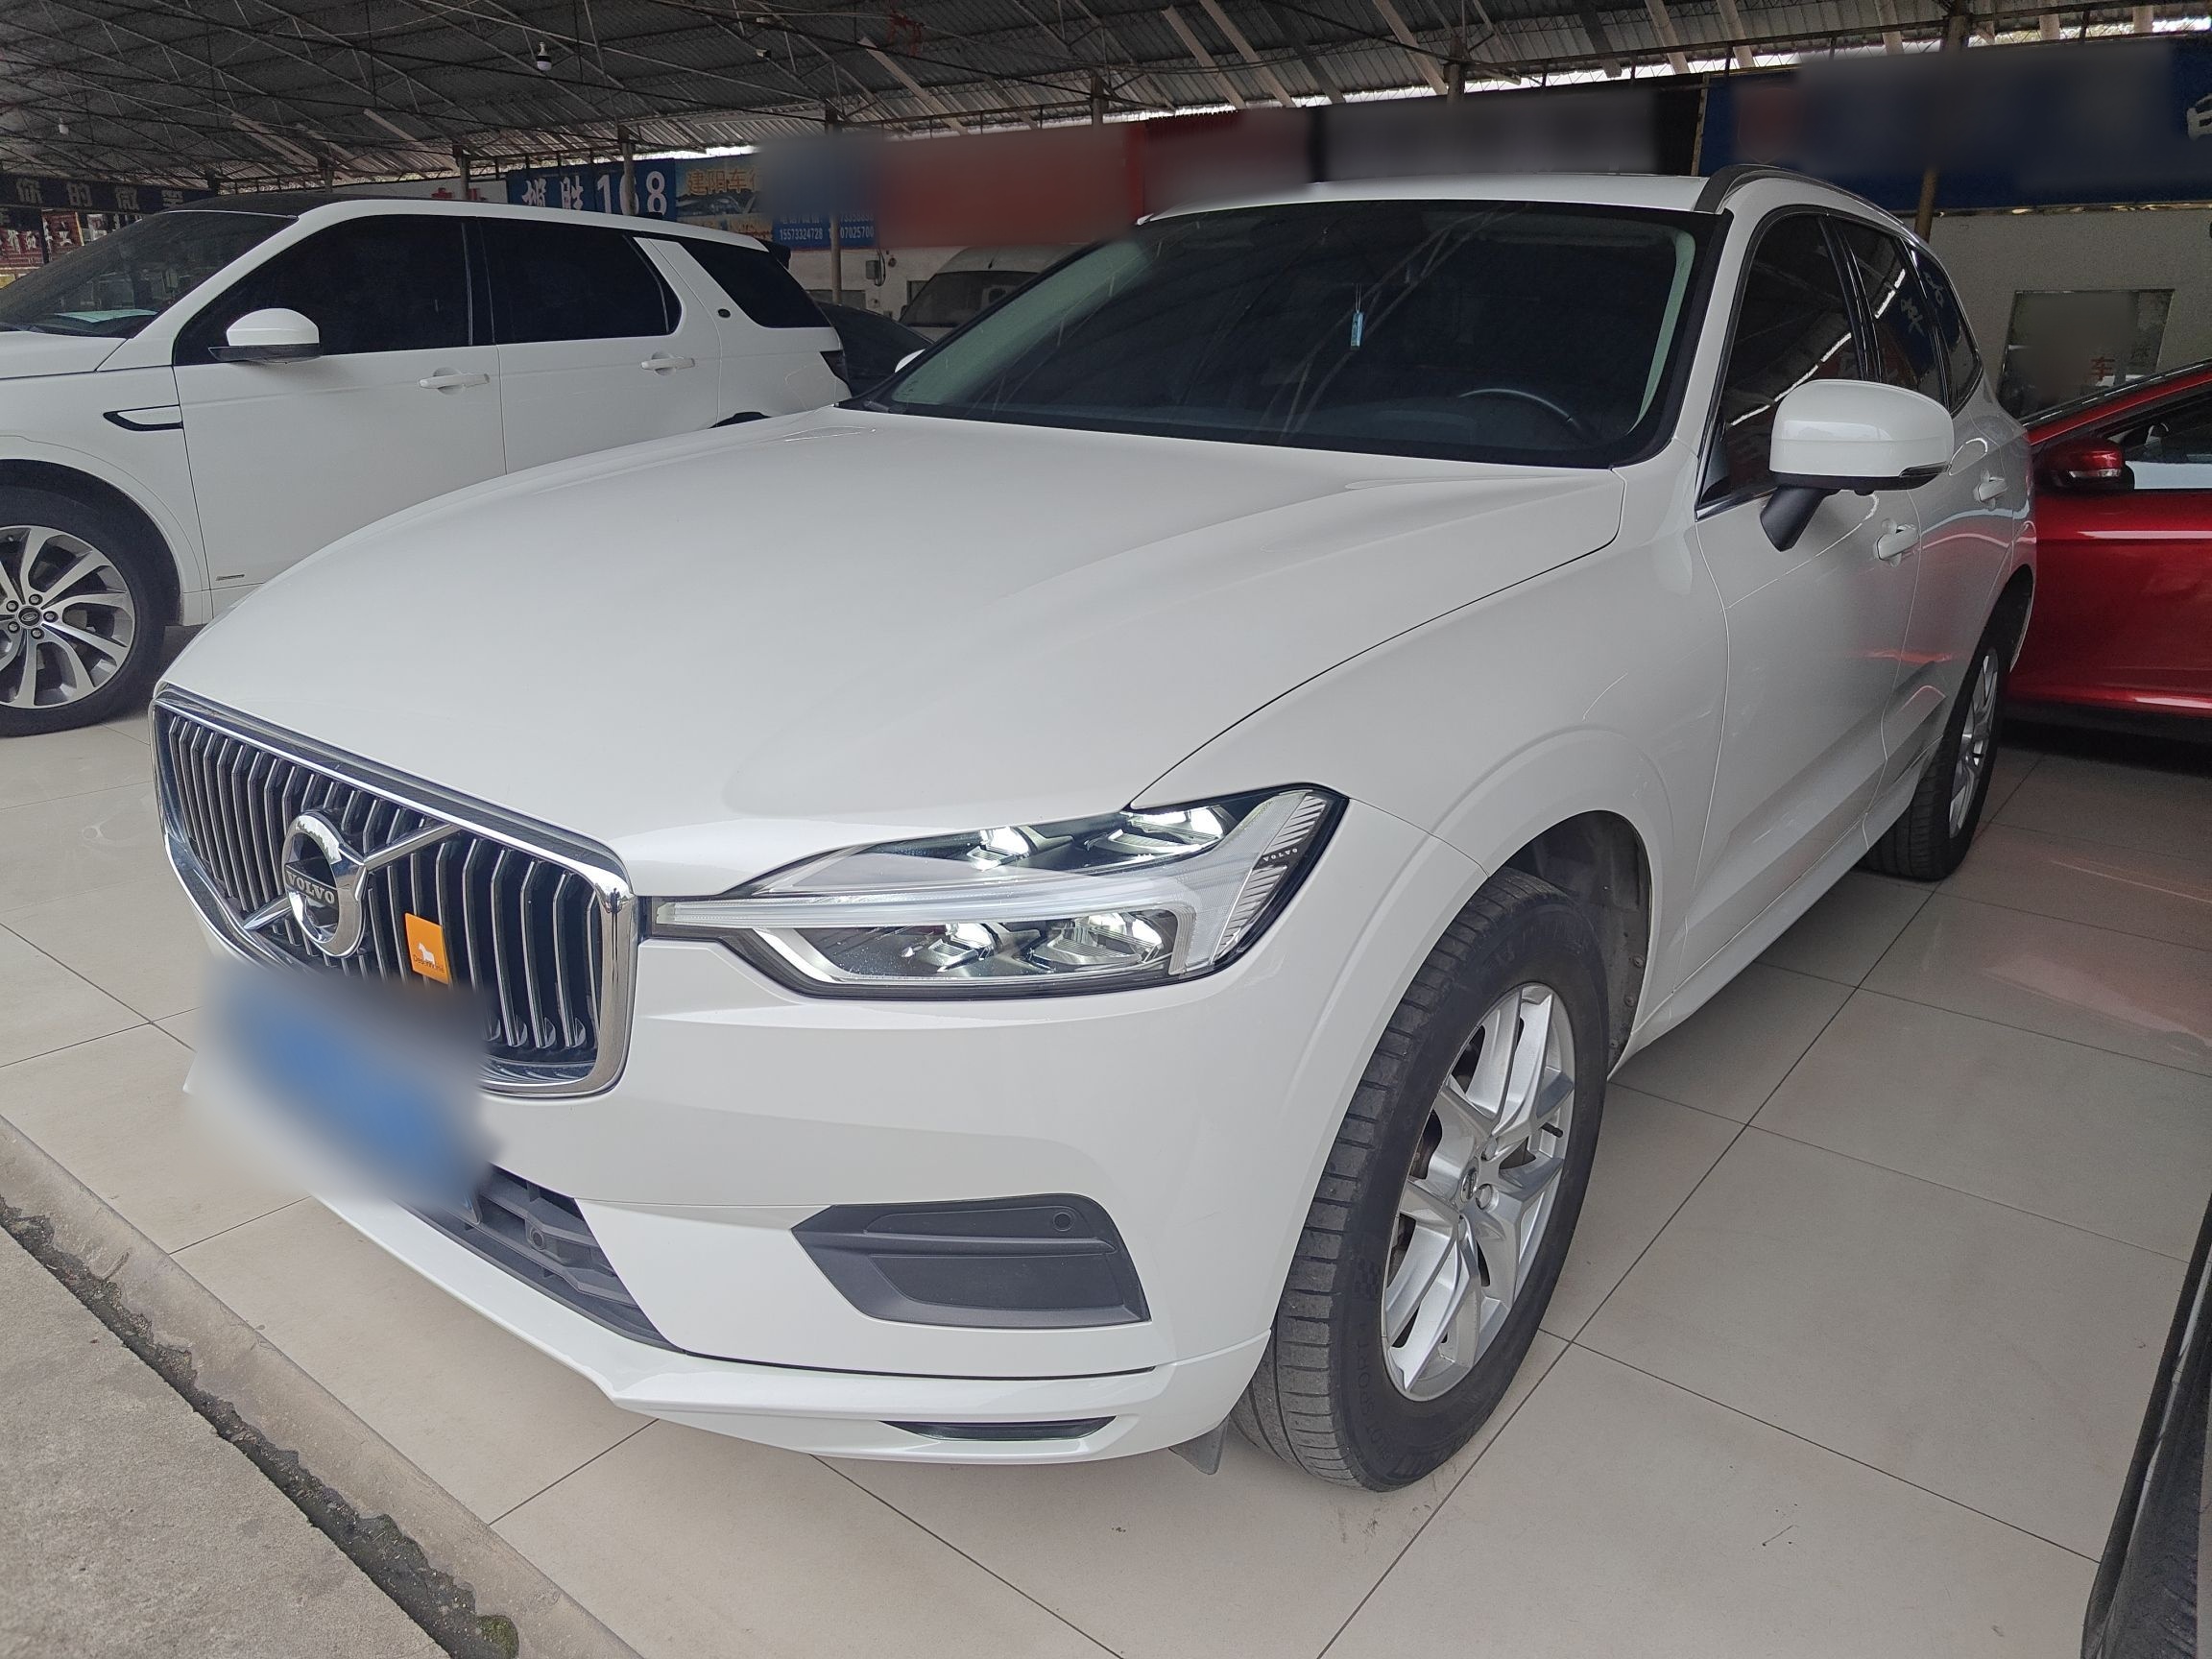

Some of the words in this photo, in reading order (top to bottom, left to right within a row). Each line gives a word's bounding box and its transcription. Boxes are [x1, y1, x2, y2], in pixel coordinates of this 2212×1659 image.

[1262, 848, 1298, 862] VOLVO
[286, 870, 335, 904] VOLVO
[1357, 1337, 1376, 1417] SPORT
